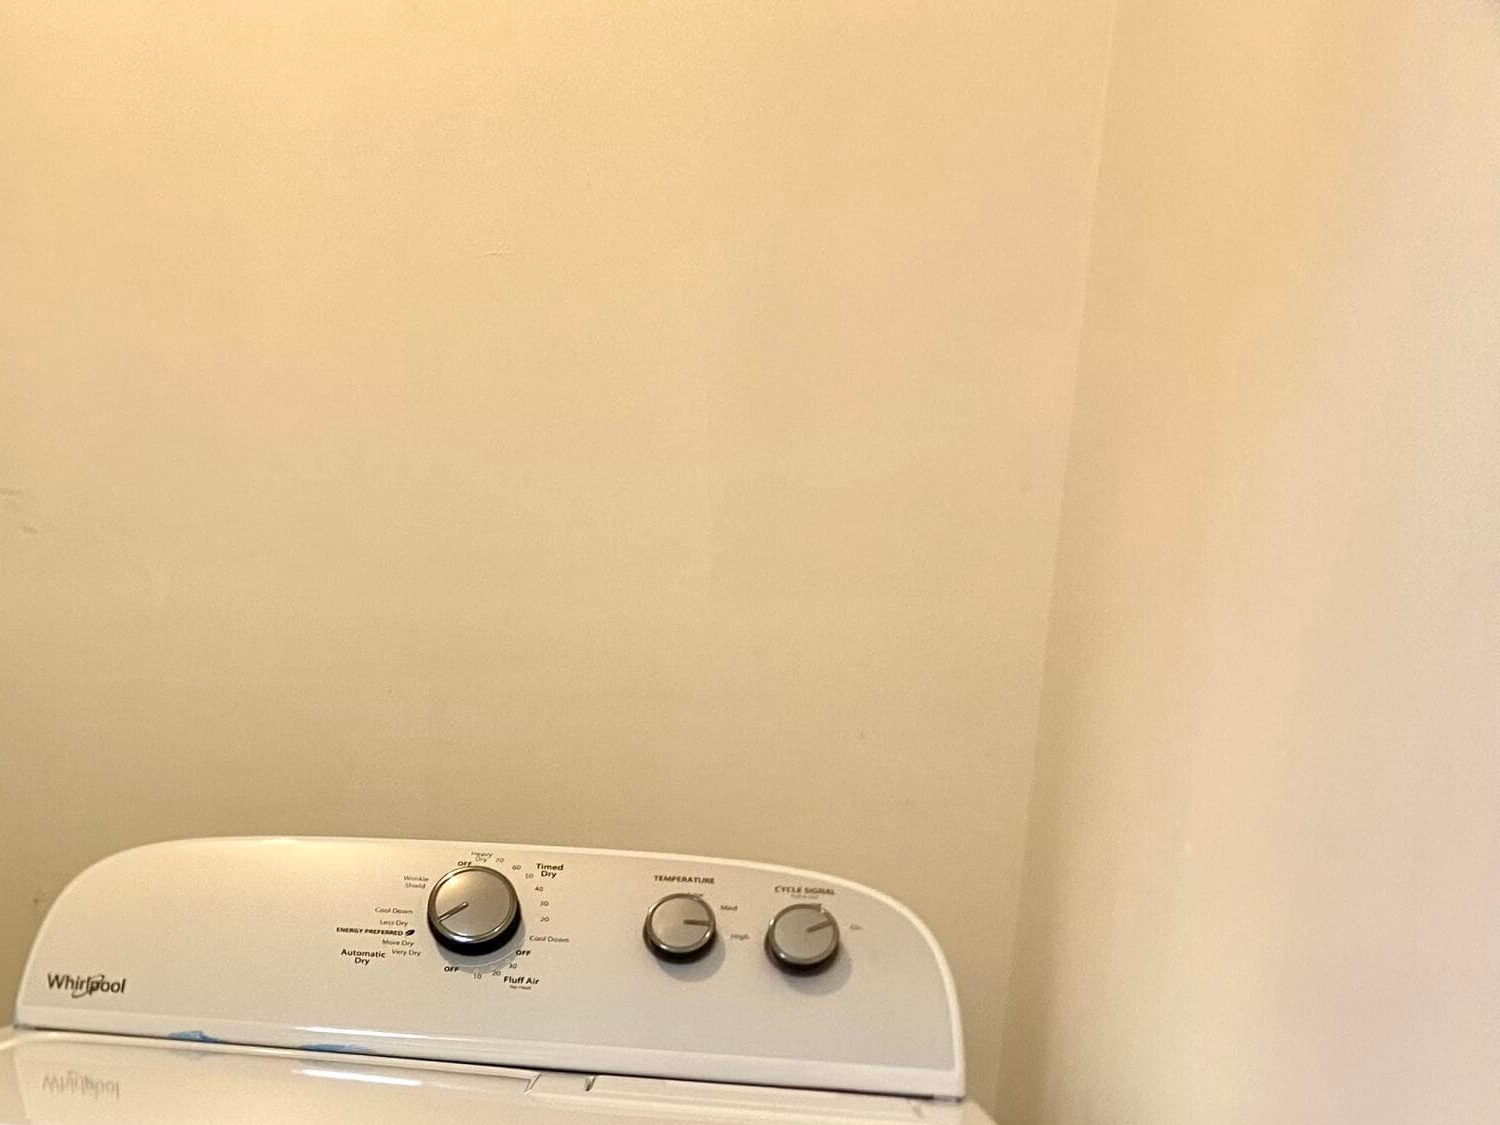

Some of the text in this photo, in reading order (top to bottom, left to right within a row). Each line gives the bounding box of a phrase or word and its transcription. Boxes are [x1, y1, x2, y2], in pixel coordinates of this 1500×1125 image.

[536, 863, 564, 871] Timed
[541, 870, 557, 878] Dry
[654, 875, 715, 884] TEMPERATURE
[774, 885, 801, 893] CYCLE
[341, 948, 386, 958] Automatic
[408, 949, 421, 957] Dry
[354, 957, 370, 965] Dry
[503, 975, 540, 985] Fluff Air
[47, 973, 126, 998] Whirlpool
